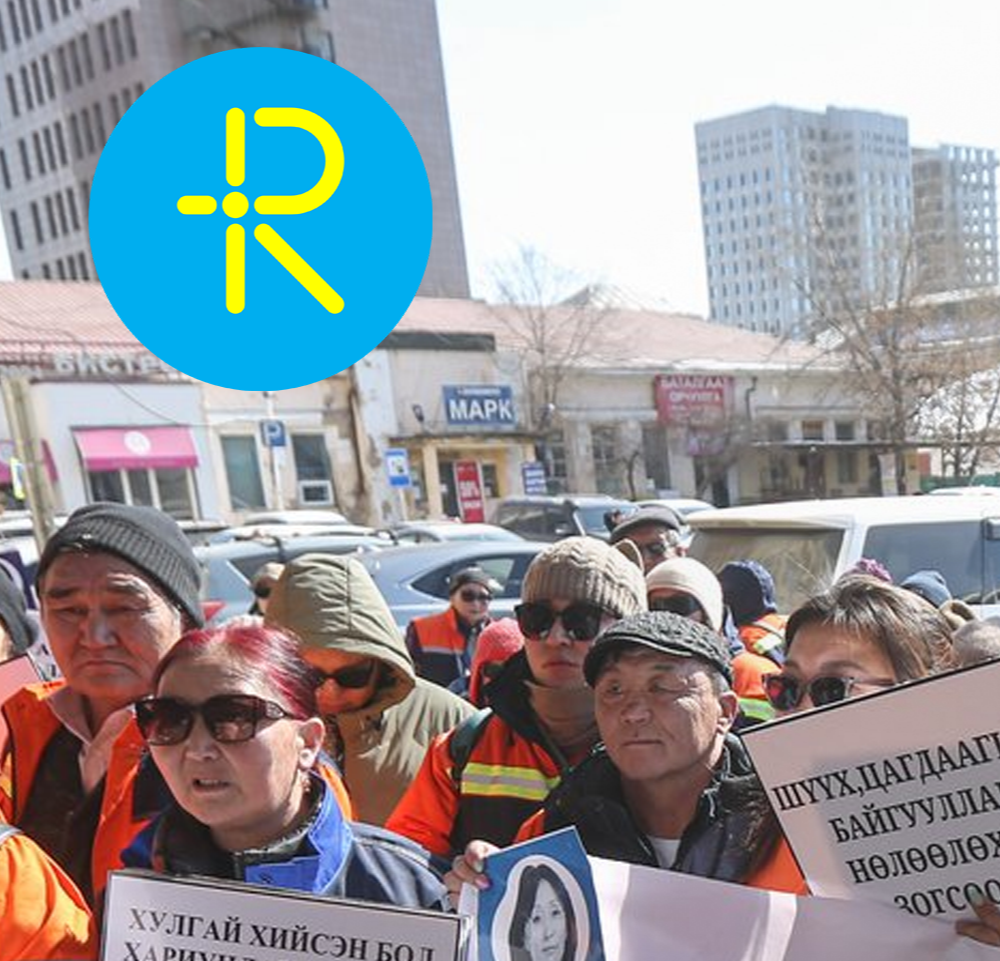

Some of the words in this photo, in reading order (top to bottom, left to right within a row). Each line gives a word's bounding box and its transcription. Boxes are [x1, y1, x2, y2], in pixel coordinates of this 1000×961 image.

[448, 399, 512, 420] МАРК
[129, 907, 243, 944] ХУЛГАЙ
[249, 924, 367, 960] ХИЙСЭН
